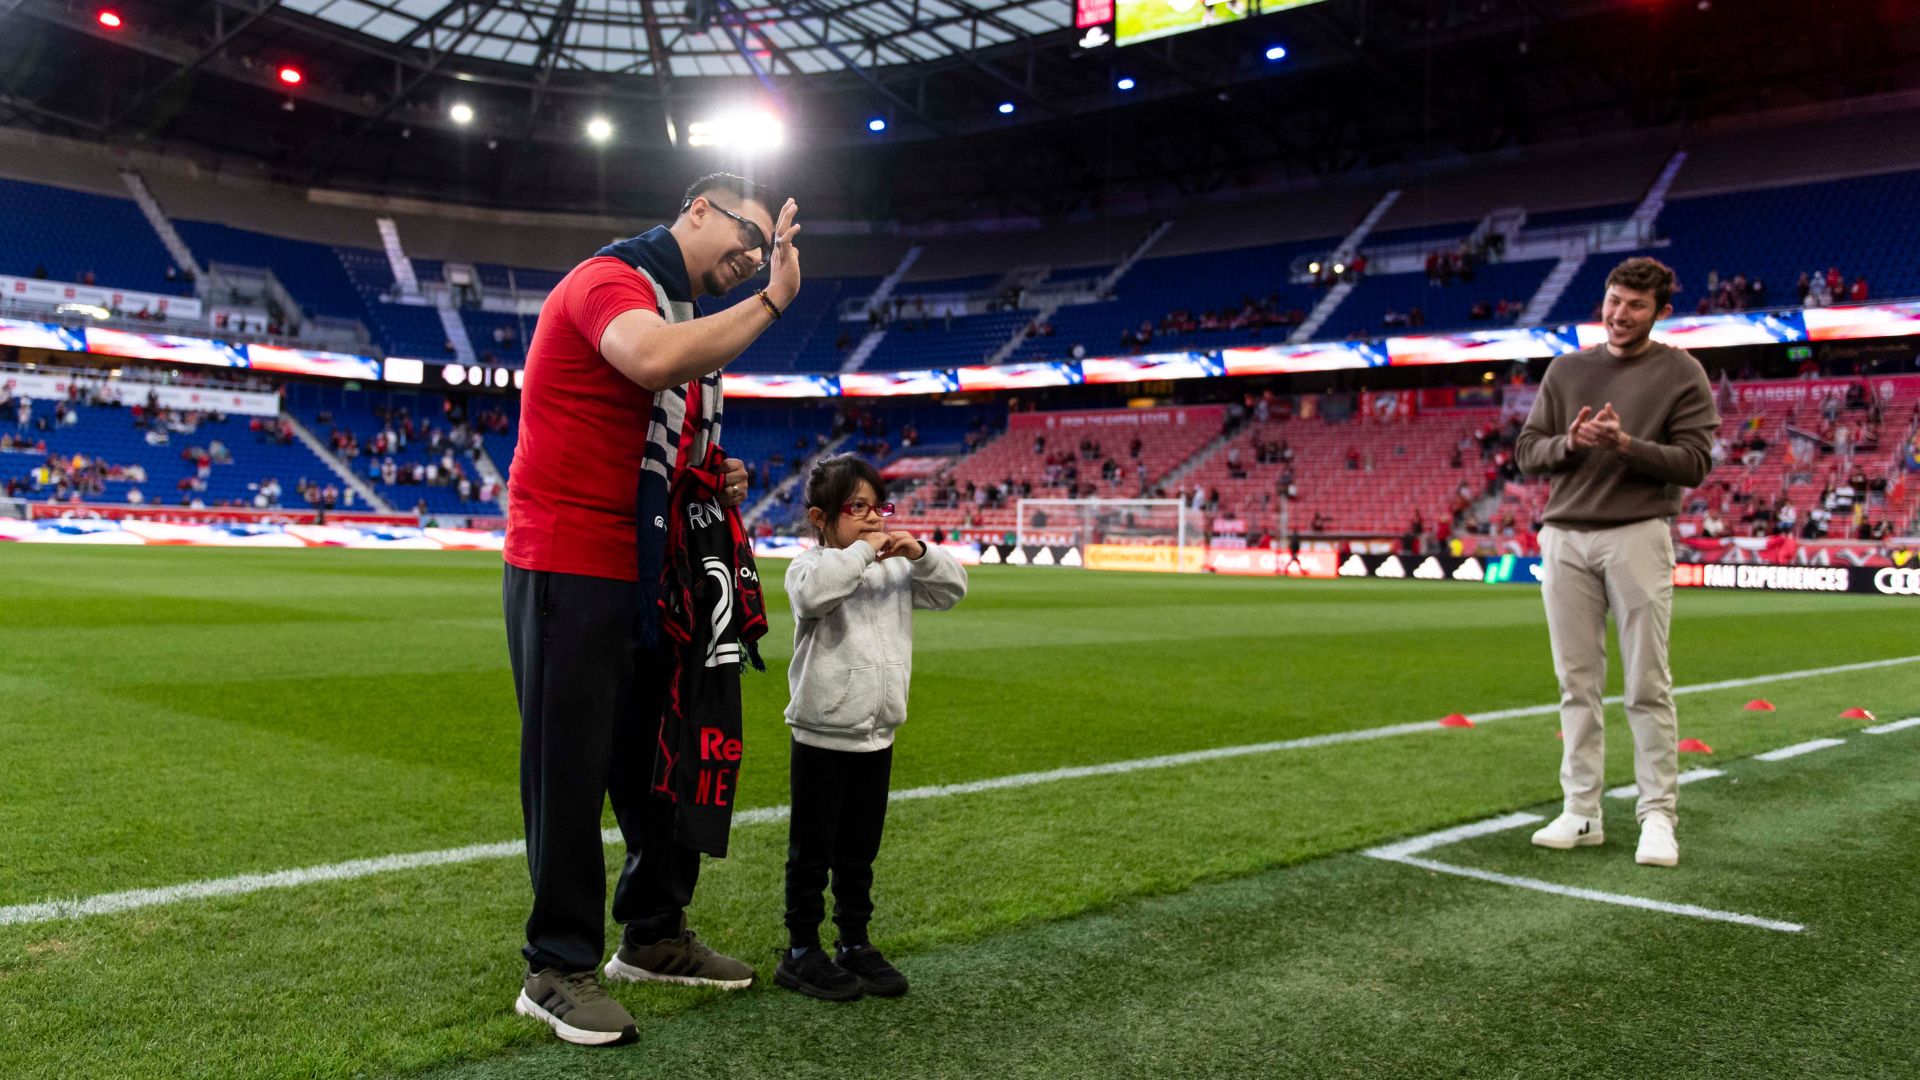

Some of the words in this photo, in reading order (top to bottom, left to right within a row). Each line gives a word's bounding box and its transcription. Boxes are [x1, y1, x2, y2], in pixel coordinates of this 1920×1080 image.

[1743, 387, 1806, 401] GARDEN
[1811, 384, 1852, 400] STAT
[1060, 416, 1085, 426] FROM
[1087, 415, 1104, 425] THE
[1105, 413, 1139, 425] EMPIRE
[1141, 412, 1170, 424] STATE
[1090, 549, 1156, 564] Continental
[1213, 553, 1250, 568] Audi
[1703, 563, 1737, 587] FAN
[1737, 564, 1850, 591] EXPERIENCES
